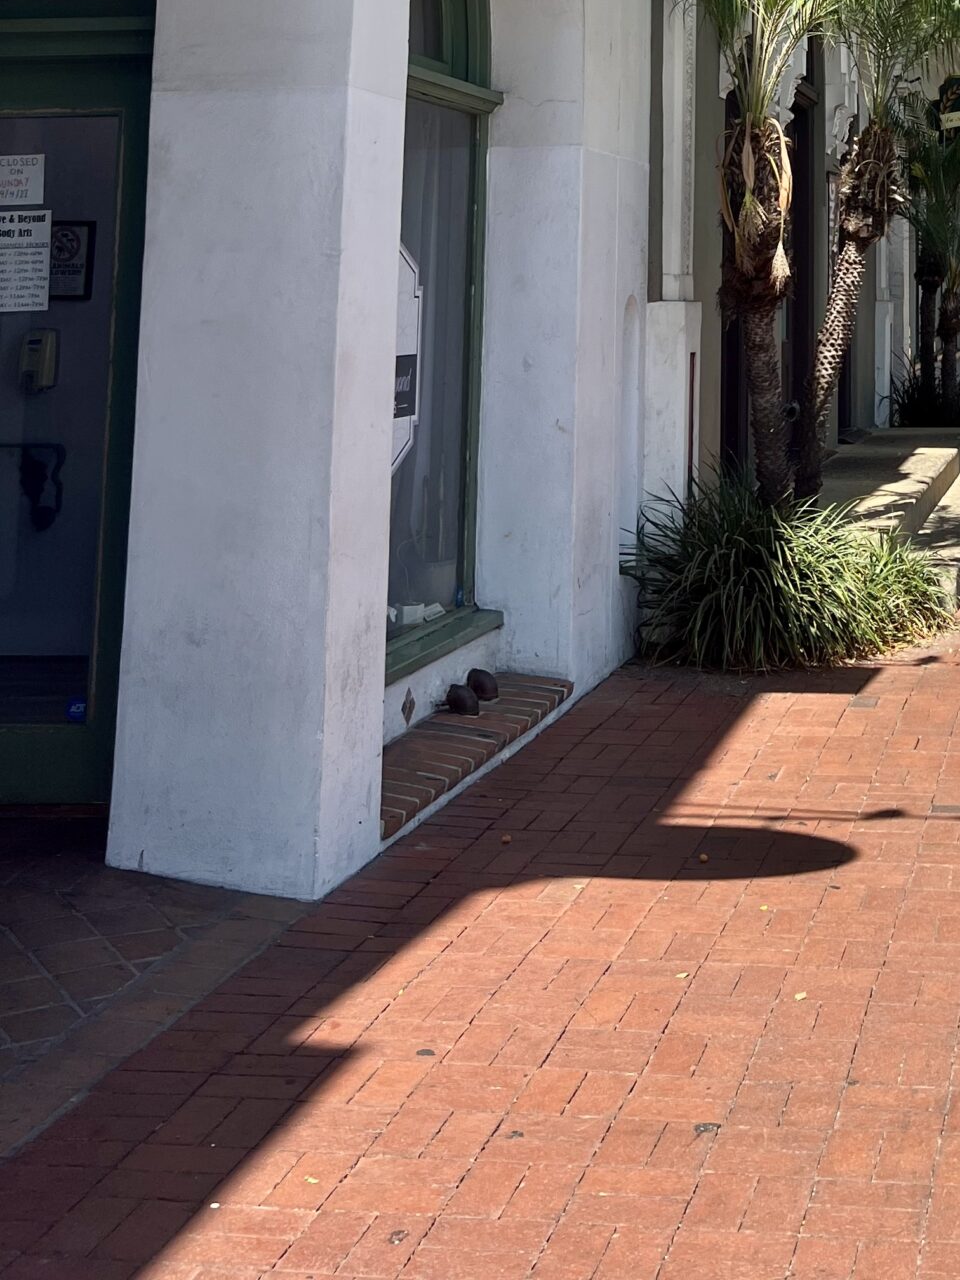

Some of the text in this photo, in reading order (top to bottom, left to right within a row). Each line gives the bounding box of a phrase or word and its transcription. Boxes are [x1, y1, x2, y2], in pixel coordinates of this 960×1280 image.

[0, 157, 38, 167] CLOSED
[10, 168, 24, 176] ON
[9, 214, 15, 223] &
[18, 213, 46, 224] Beyond
[18, 228, 32, 237] Arts
[69, 703, 87, 713] ADT
